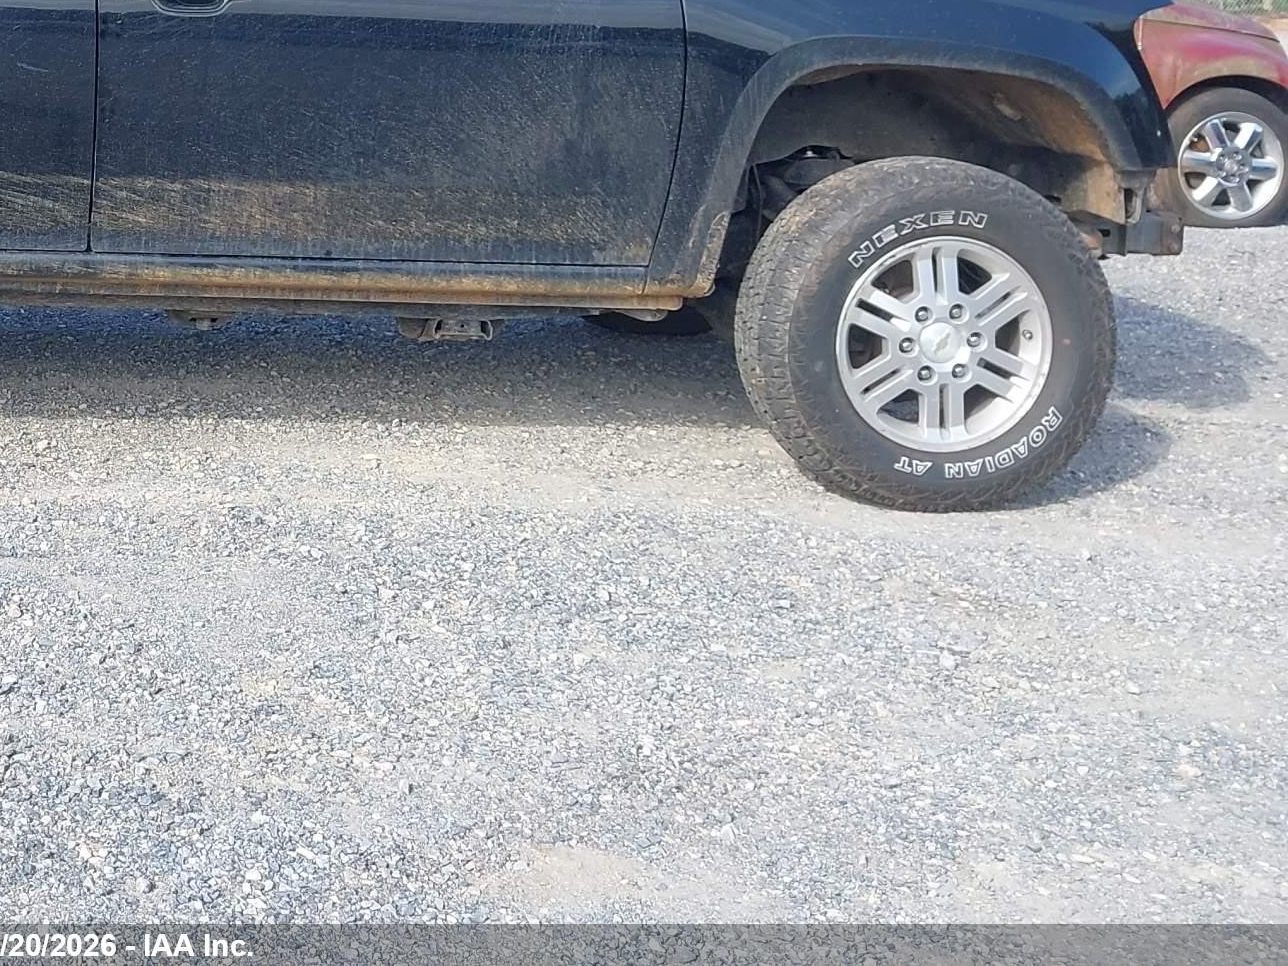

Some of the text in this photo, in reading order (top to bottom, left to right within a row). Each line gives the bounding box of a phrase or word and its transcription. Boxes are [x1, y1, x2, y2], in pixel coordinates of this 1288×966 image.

[846, 209, 989, 269] NEXEN
[893, 406, 1064, 479] ROADIAN AT
